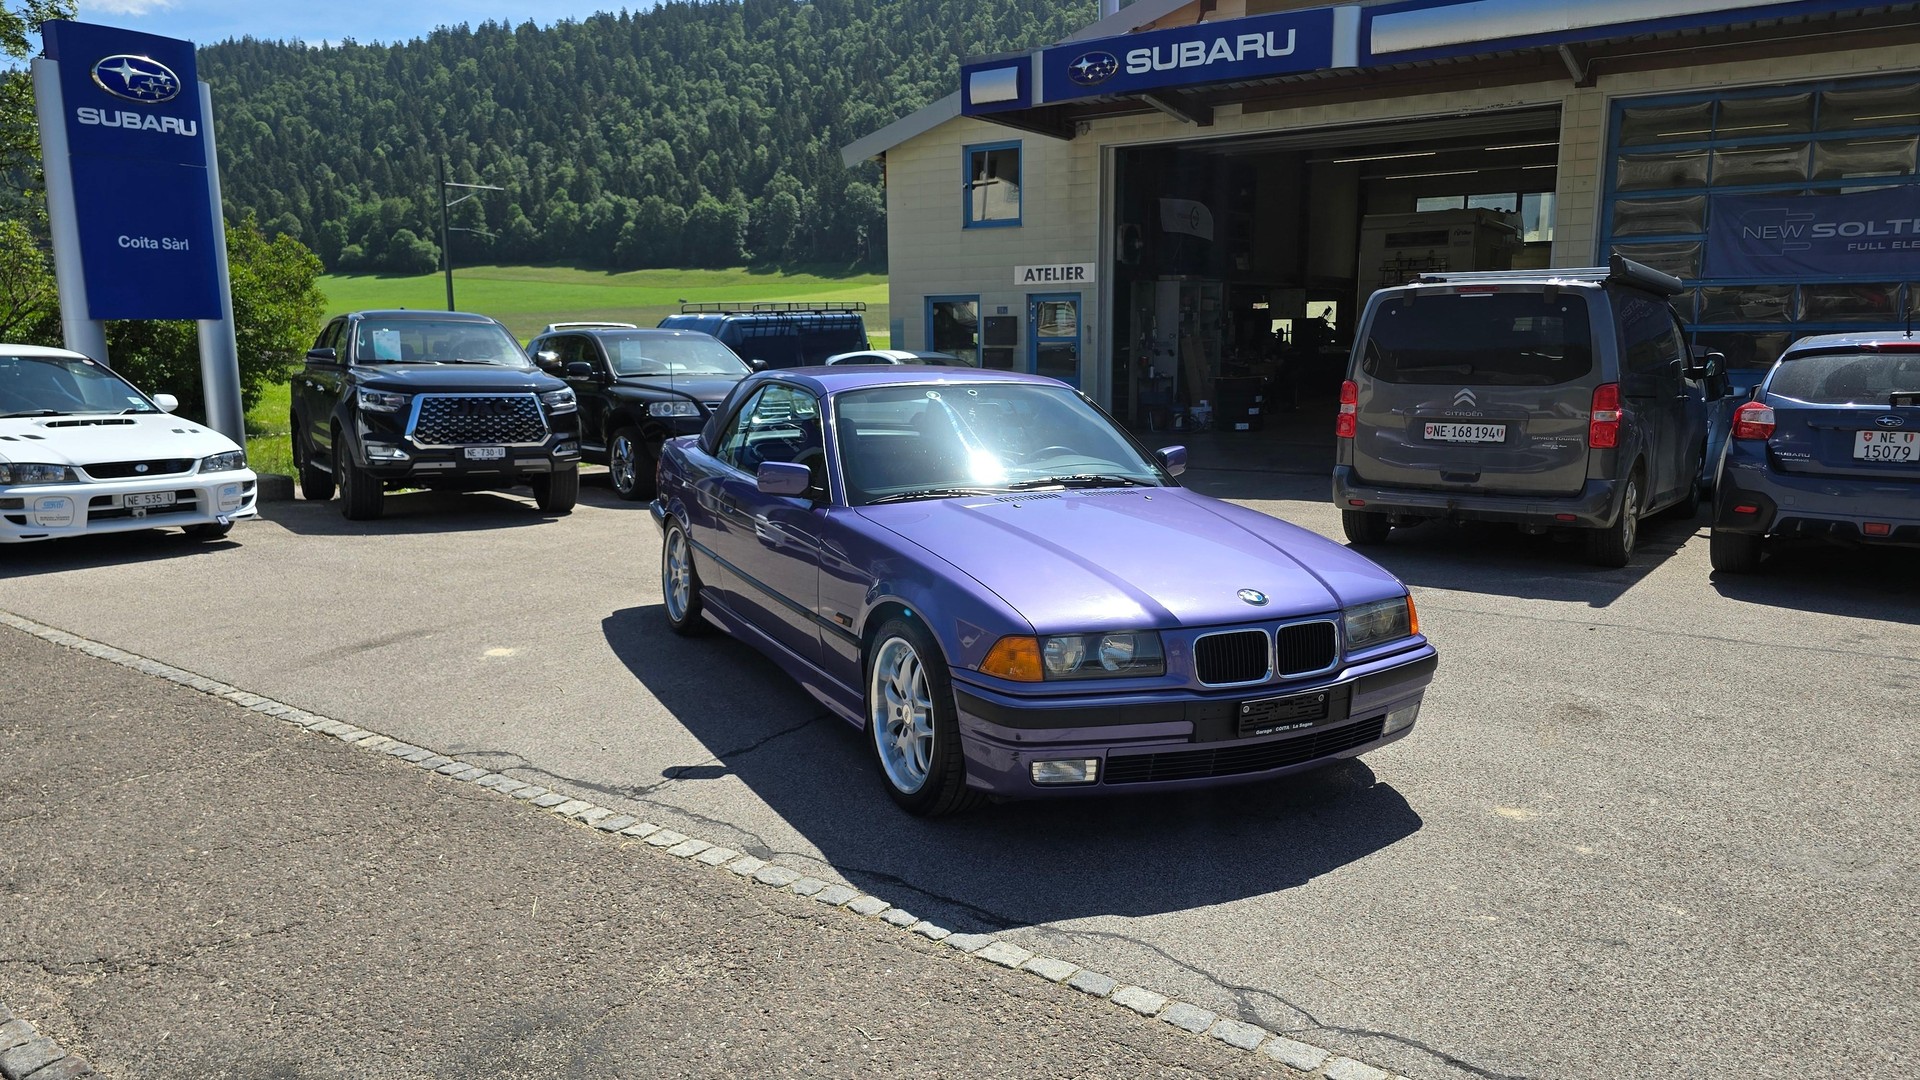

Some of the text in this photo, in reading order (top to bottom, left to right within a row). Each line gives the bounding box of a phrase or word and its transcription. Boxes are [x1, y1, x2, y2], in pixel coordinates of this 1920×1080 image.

[1126, 28, 1296, 75] SUBARU
[77, 107, 197, 136] SUBARU
[1743, 224, 1805, 239] NEW
[118, 235, 189, 251] Coita Sàrl
[1847, 241, 1887, 251] FULL
[1024, 266, 1084, 281] ATELIER
[1880, 433, 1896, 443] NE
[1864, 445, 1911, 460] 15079
[128, 496, 139, 505] NE
[145, 494, 163, 504] 535
